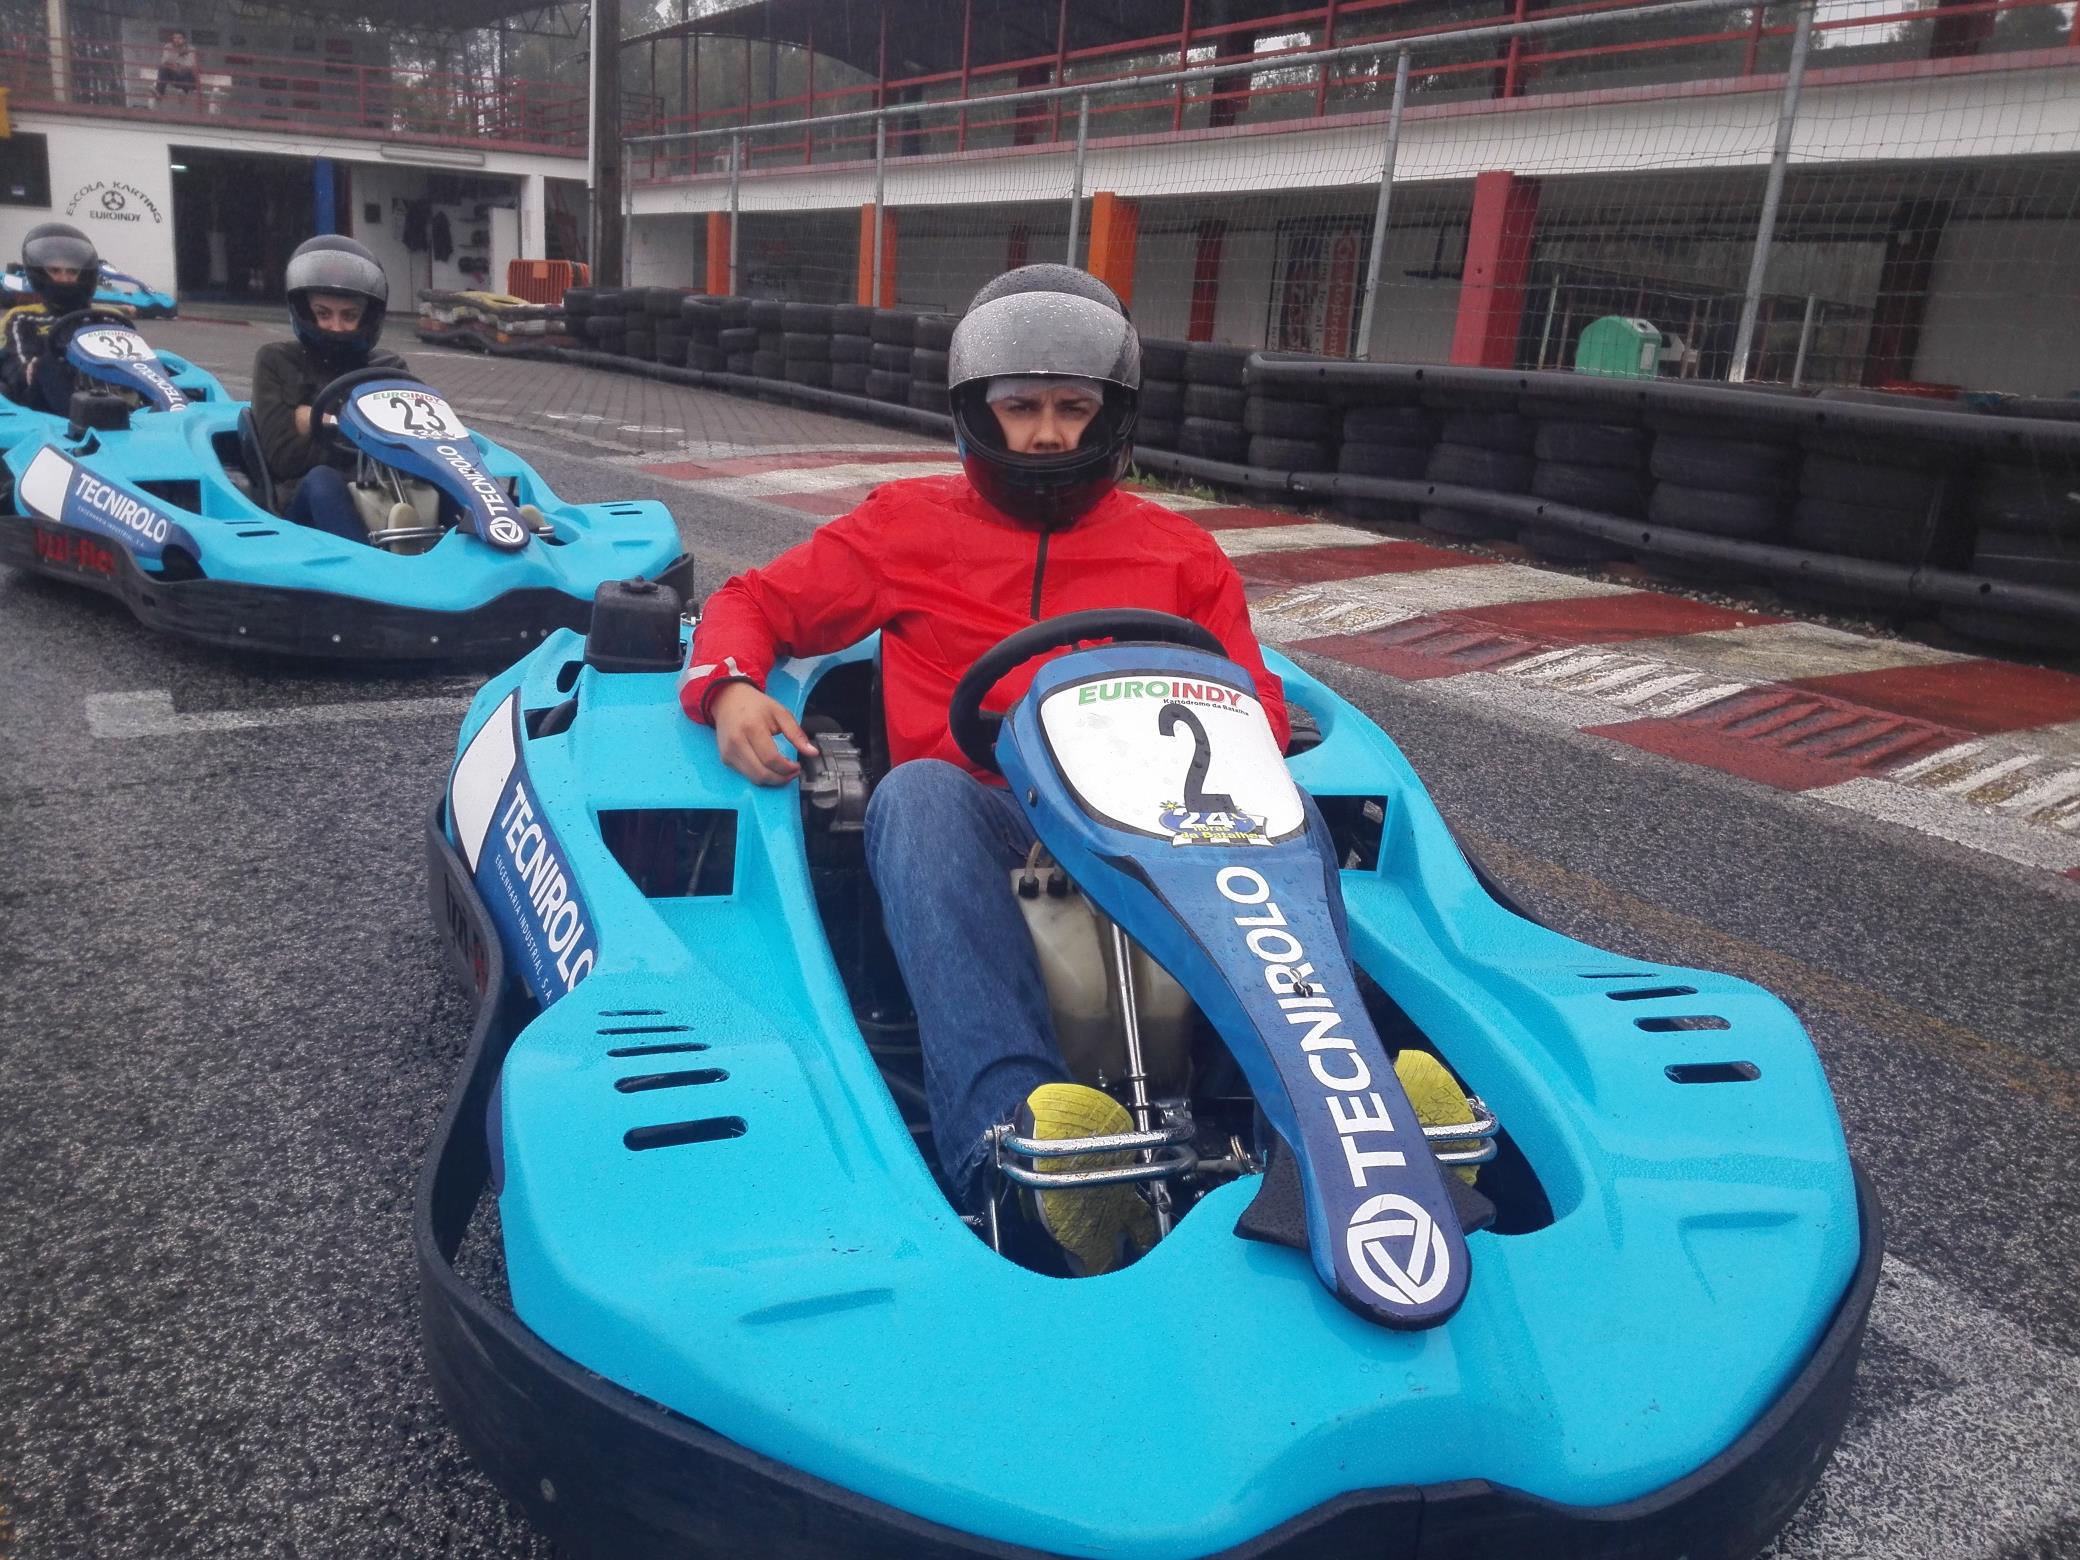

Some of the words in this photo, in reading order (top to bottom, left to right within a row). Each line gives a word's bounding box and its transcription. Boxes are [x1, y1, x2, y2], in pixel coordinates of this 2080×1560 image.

[66, 181, 105, 217] ESCOLA
[113, 181, 163, 224] KARTING
[89, 210, 142, 222] EUROINDY
[99, 335, 142, 358] 32
[373, 392, 440, 404] EUROINDY
[390, 397, 446, 430] 23
[436, 444, 510, 516] TECNIROLO
[74, 472, 168, 544] TECNIROLO
[1078, 680, 1243, 707] EUROINDY
[1158, 703, 1238, 814] 2
[1173, 807, 1237, 829] 24
[494, 853, 521, 916] ENGENHARIA
[541, 978, 554, 1005] S.A.
[1215, 865, 1407, 1189] TECNIROLO
